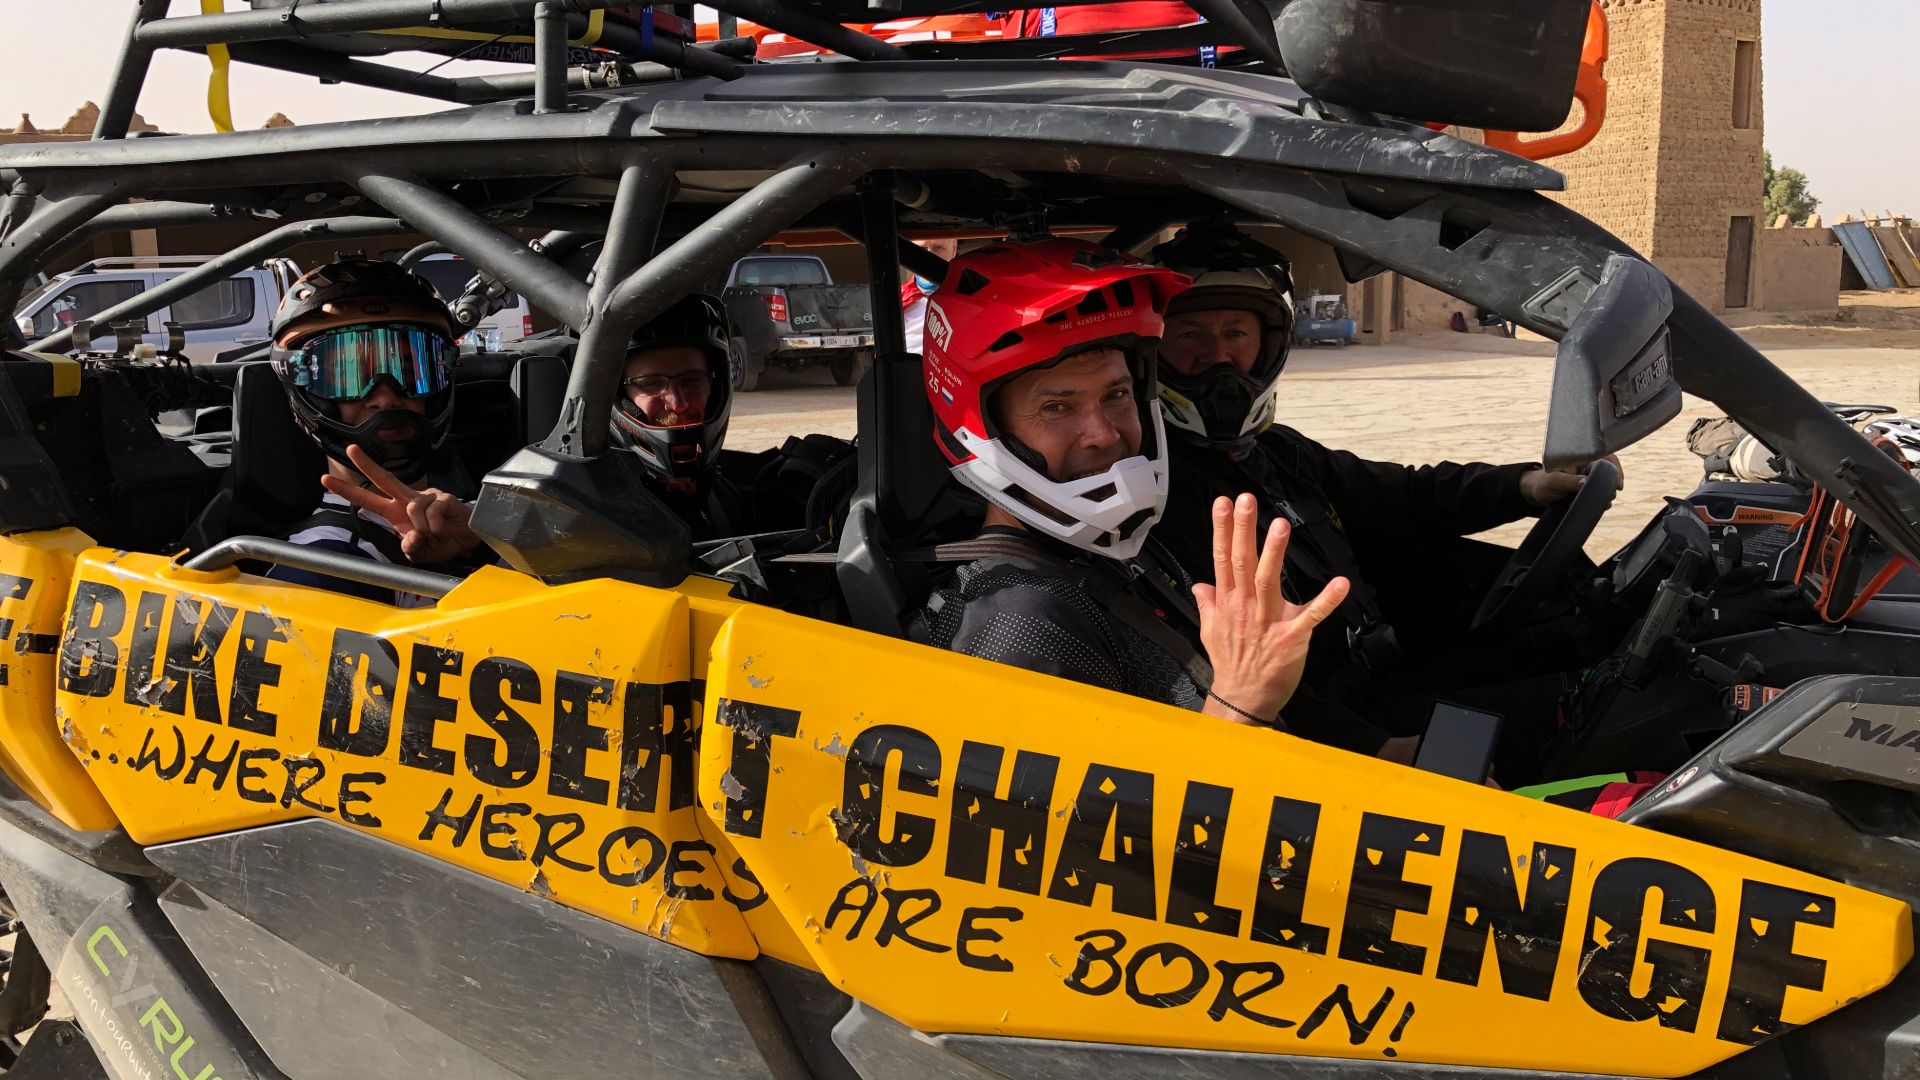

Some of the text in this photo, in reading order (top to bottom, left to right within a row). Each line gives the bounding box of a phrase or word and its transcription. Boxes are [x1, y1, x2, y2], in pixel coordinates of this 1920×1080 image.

[928, 311, 948, 348] 100%
[929, 371, 940, 394] 25
[1634, 354, 1669, 393] can-am
[1738, 513, 1774, 521] WARNING
[317, 627, 802, 839] DESERT
[831, 725, 1837, 1046] CHALLENGE
[418, 788, 770, 912] HEROES
[824, 878, 1026, 973] ARE
[1063, 928, 1416, 1058] BORN!
[86, 925, 223, 1080] CYRU
